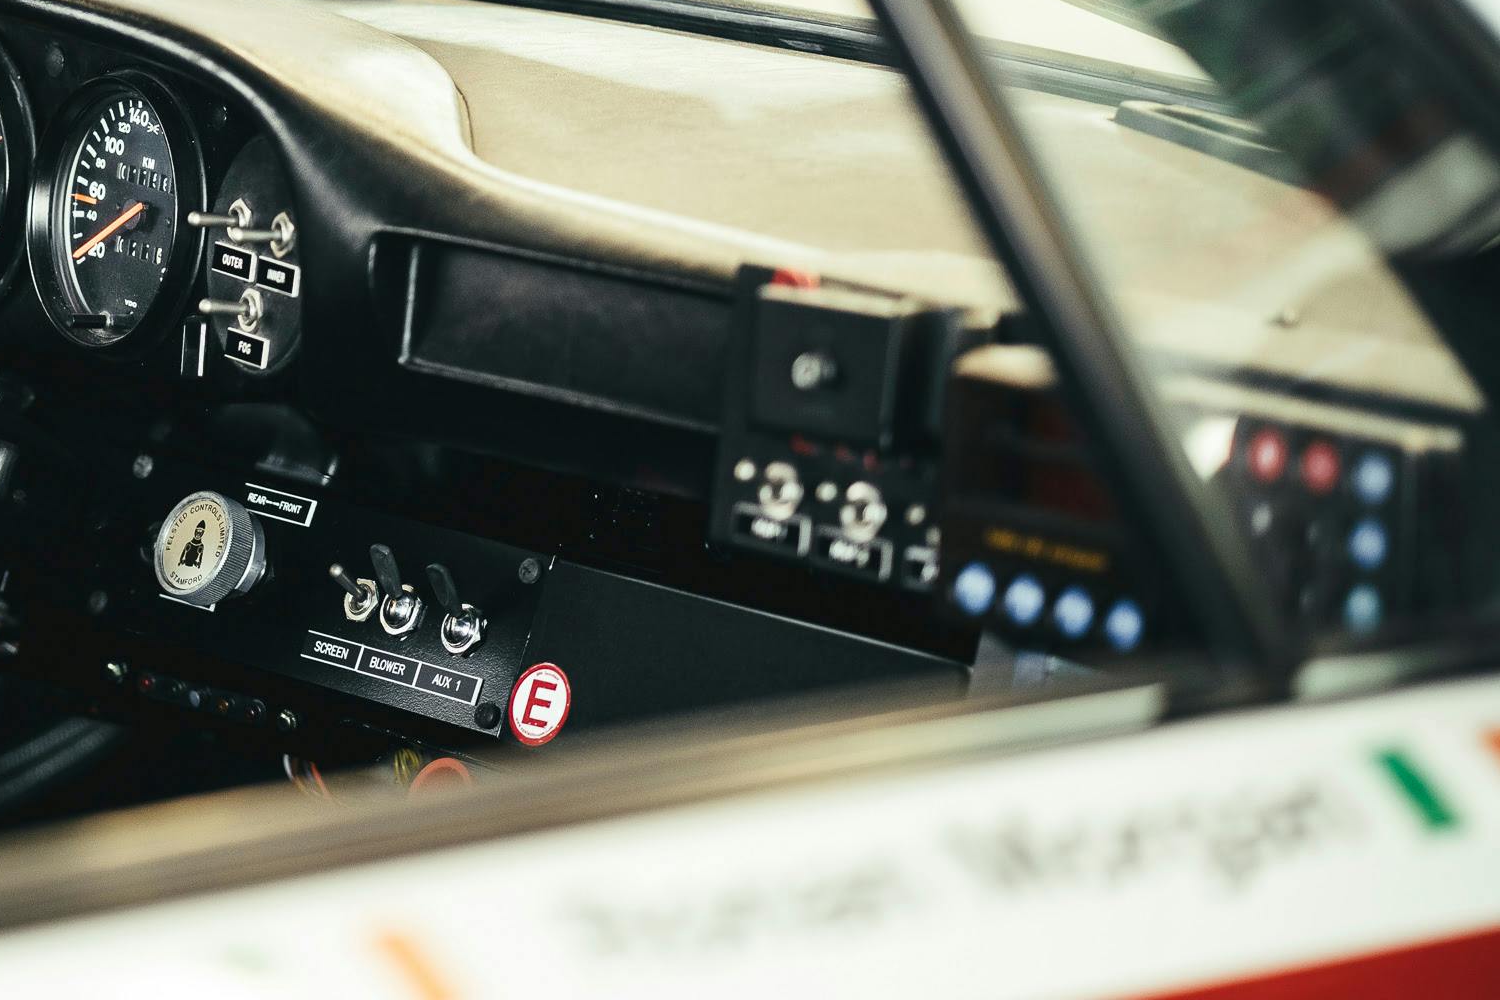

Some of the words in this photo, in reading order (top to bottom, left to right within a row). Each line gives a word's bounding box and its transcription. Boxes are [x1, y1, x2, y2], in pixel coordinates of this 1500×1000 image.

[129, 107, 149, 127] 140
[118, 122, 131, 134] 120
[105, 136, 125, 156] 100
[95, 157, 106, 169] 80
[142, 156, 155, 170] KM
[89, 181, 106, 200] 60
[86, 209, 98, 222] 40
[222, 253, 244, 270] OUTER
[124, 298, 137, 308] VDO
[238, 340, 252, 355] FOG
[165, 512, 188, 551] FELSTED
[190, 503, 223, 521] CONTROLS
[215, 521, 226, 558] LIMITED
[169, 571, 203, 585] STAMFORD
[313, 640, 349, 660] SCREEN
[369, 656, 406, 676] BLOWER
[431, 673, 453, 689] AUX
[455, 680, 462, 692] 1
[521, 678, 558, 729] E
